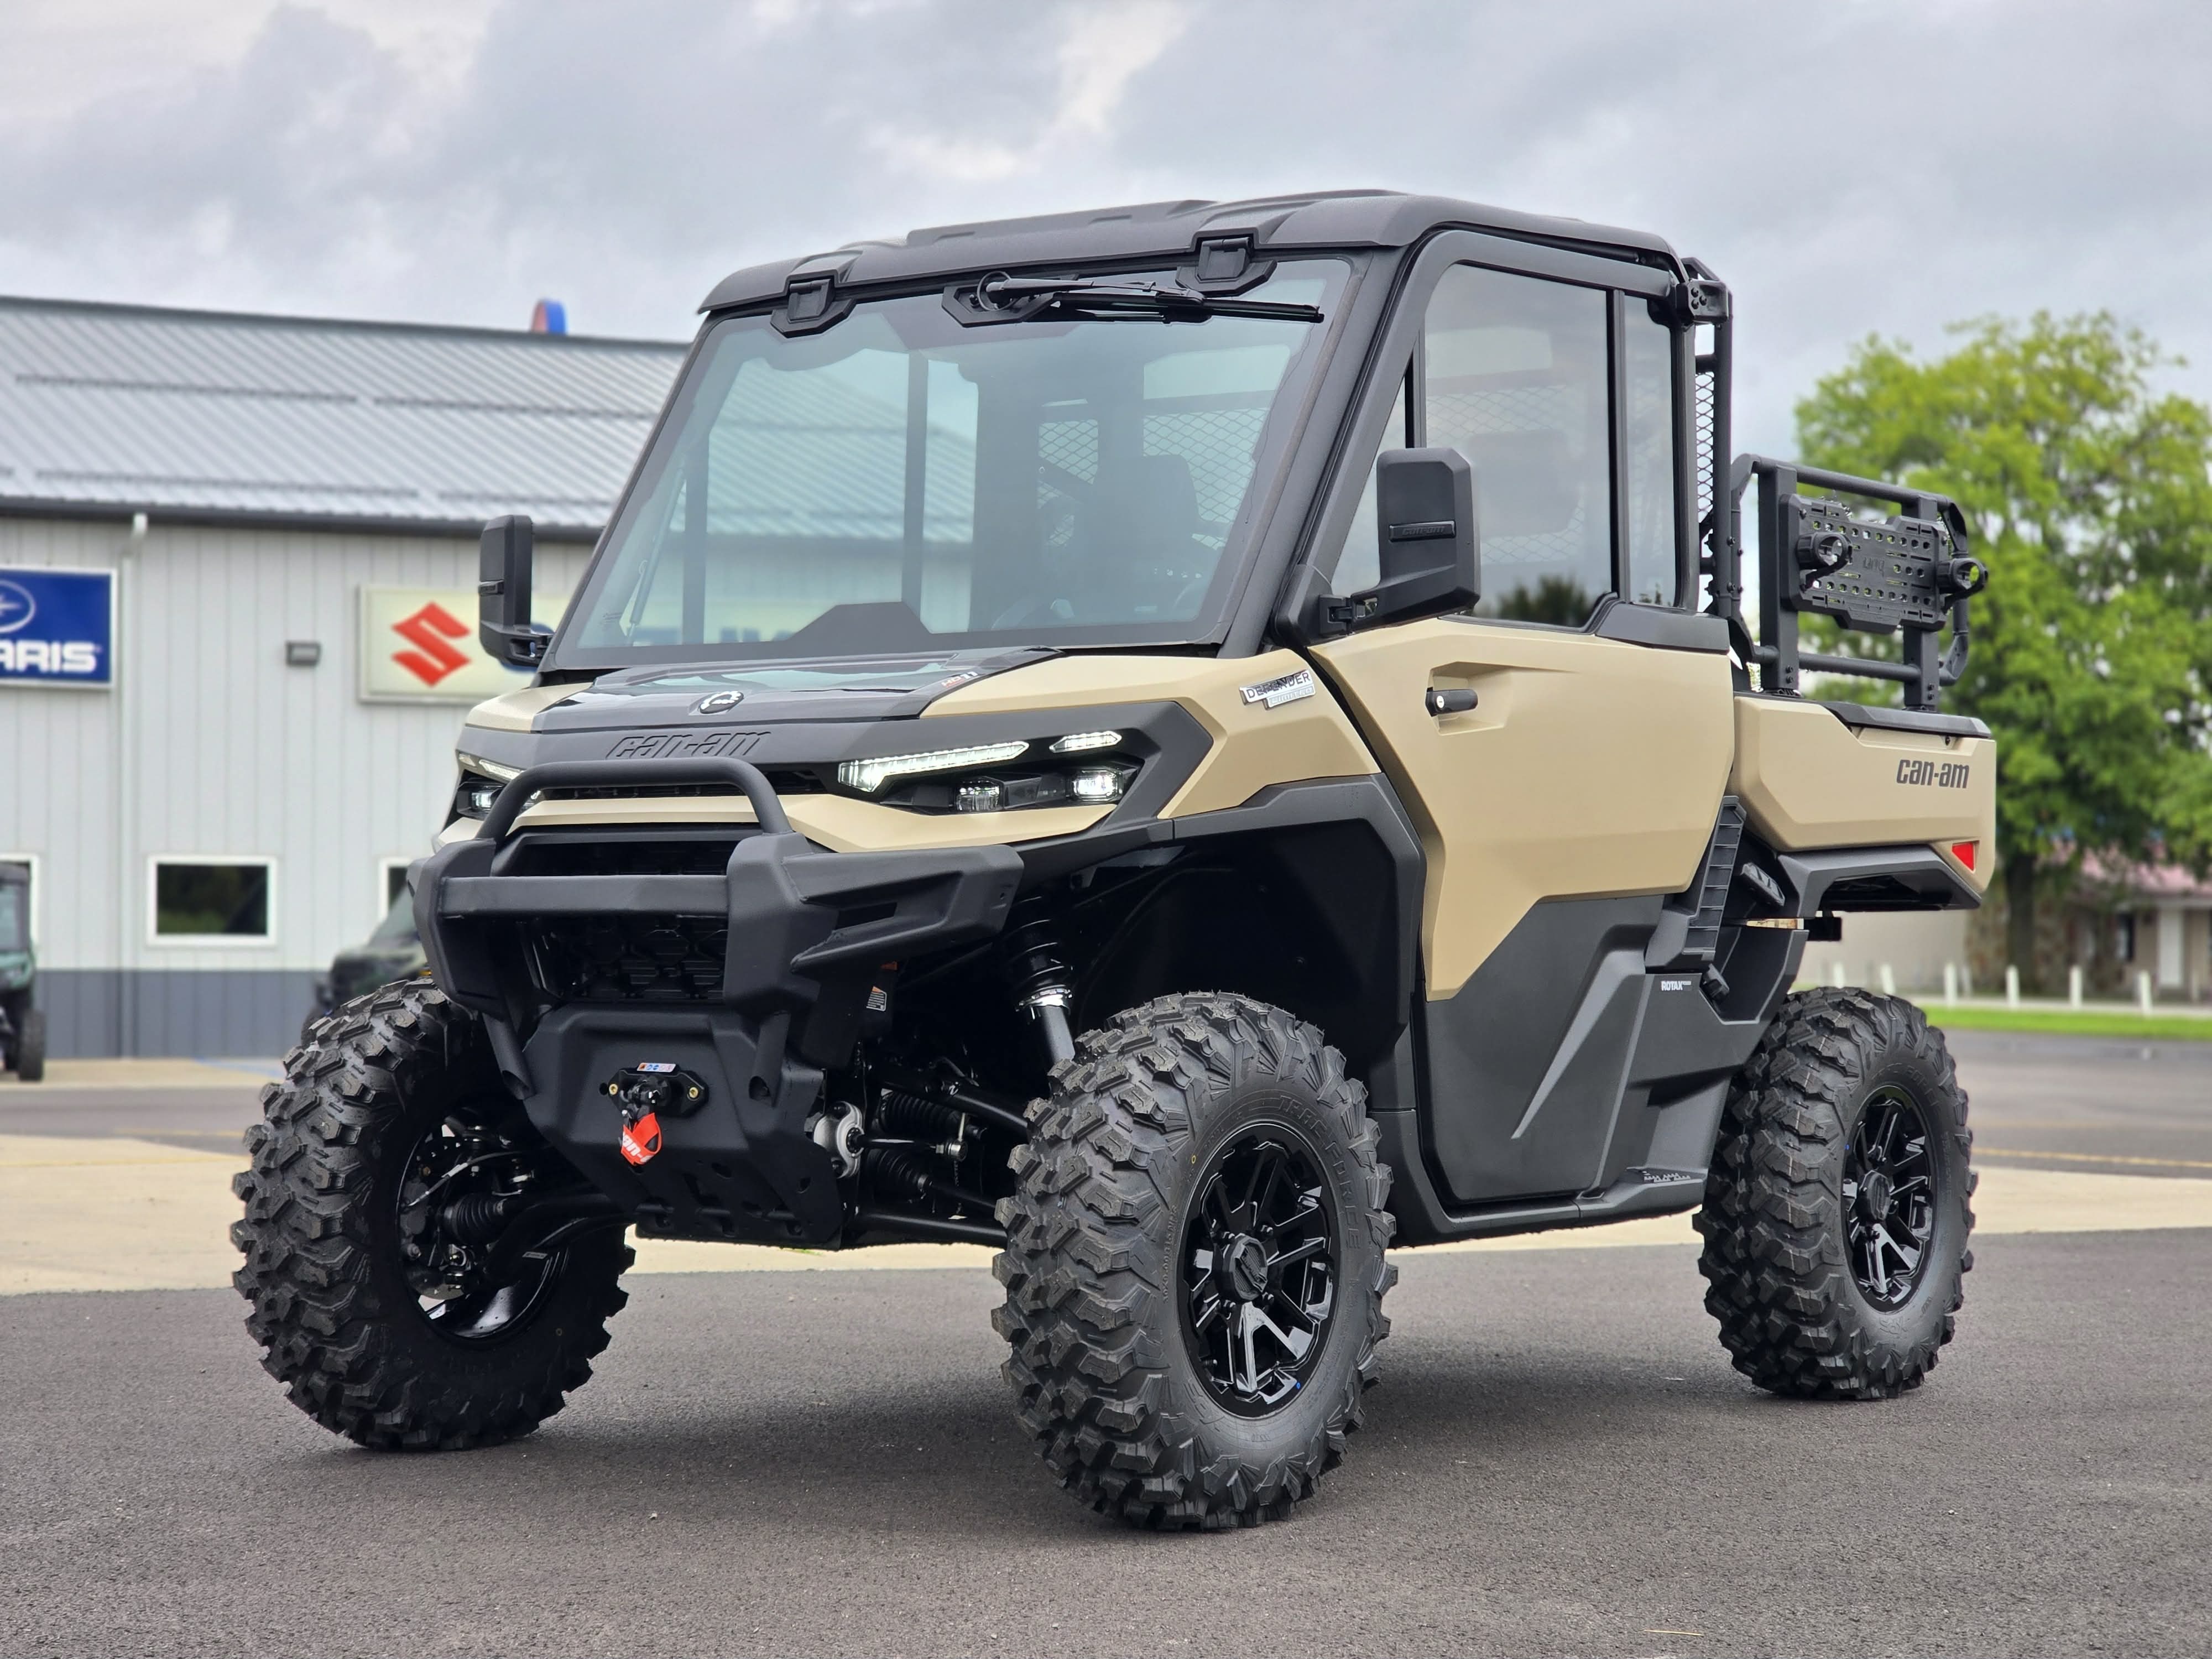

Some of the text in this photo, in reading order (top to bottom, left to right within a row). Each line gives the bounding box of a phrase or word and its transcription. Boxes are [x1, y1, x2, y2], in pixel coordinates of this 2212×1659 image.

[1246, 672, 1311, 699] DEFENDER
[606, 732, 771, 759] can-am
[1896, 759, 1970, 789] can-am
[1661, 980, 1683, 991] ROTAX
[1325, 1142, 1361, 1249] FORCE
